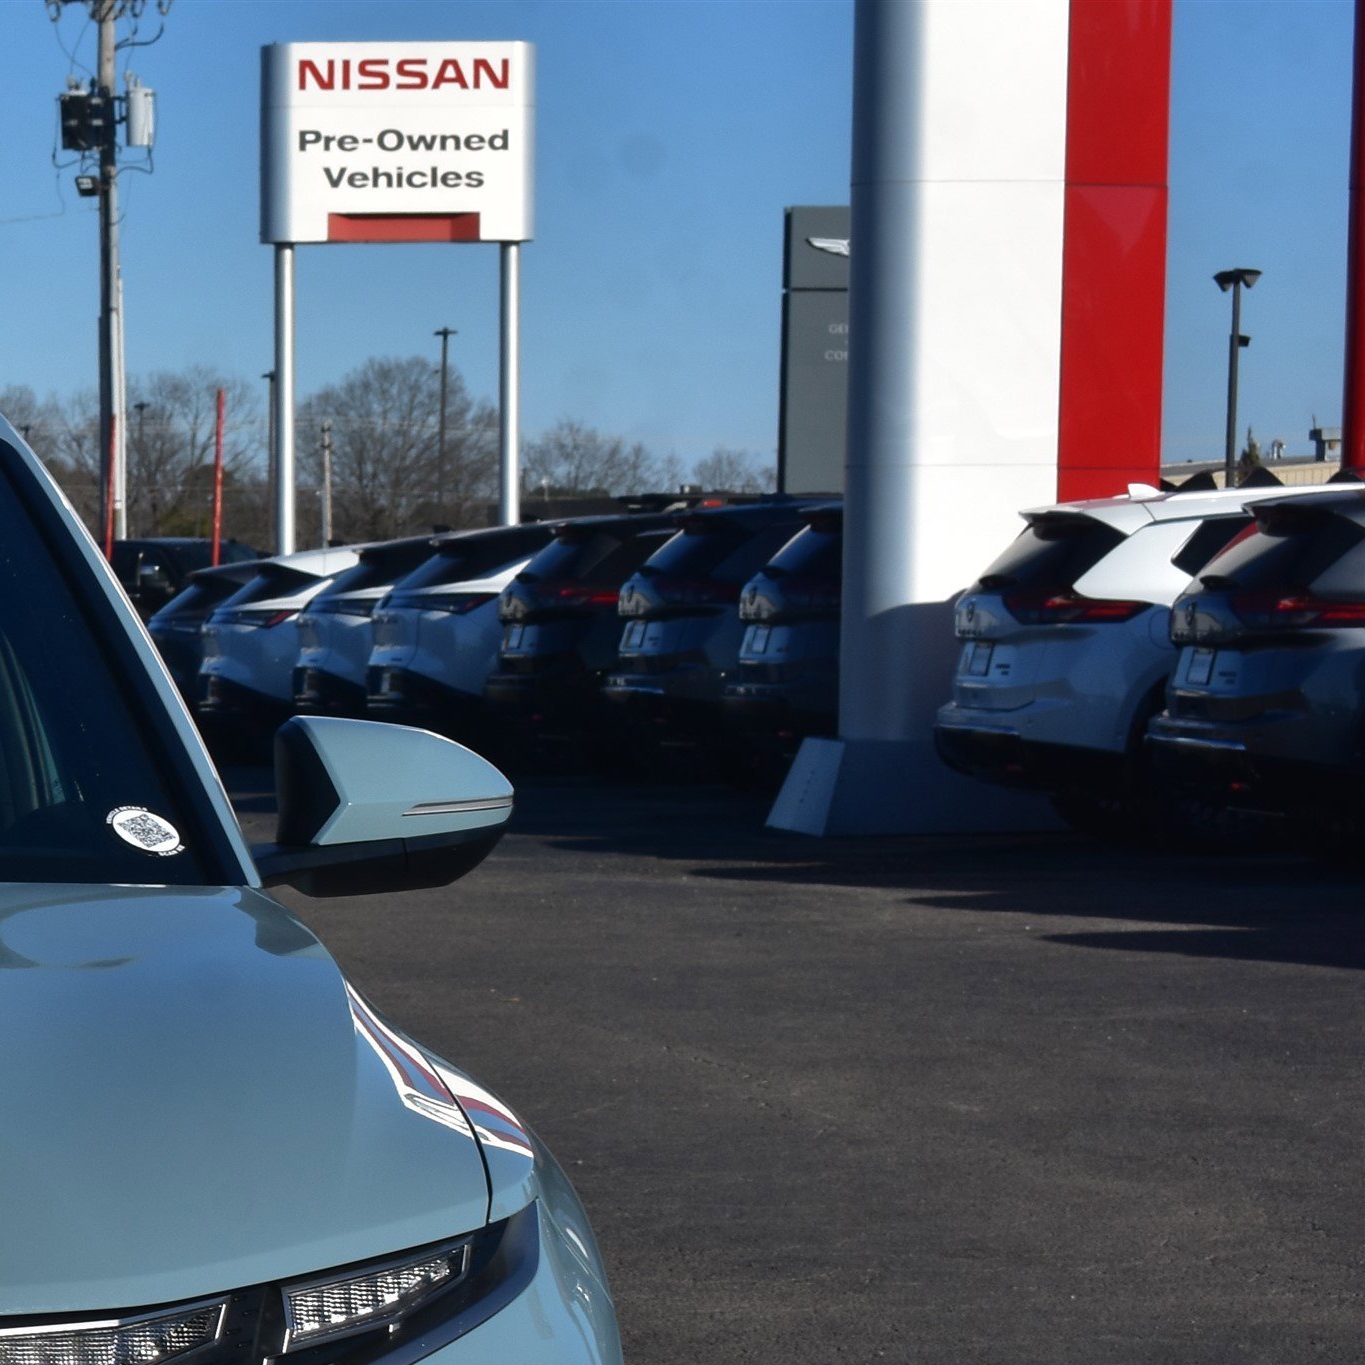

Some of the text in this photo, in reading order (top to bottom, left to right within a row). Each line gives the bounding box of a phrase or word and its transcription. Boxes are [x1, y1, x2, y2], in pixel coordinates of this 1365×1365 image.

[298, 58, 509, 90] NISSAN
[298, 129, 509, 152] Pre-Owned
[323, 166, 485, 189] Vehicles
